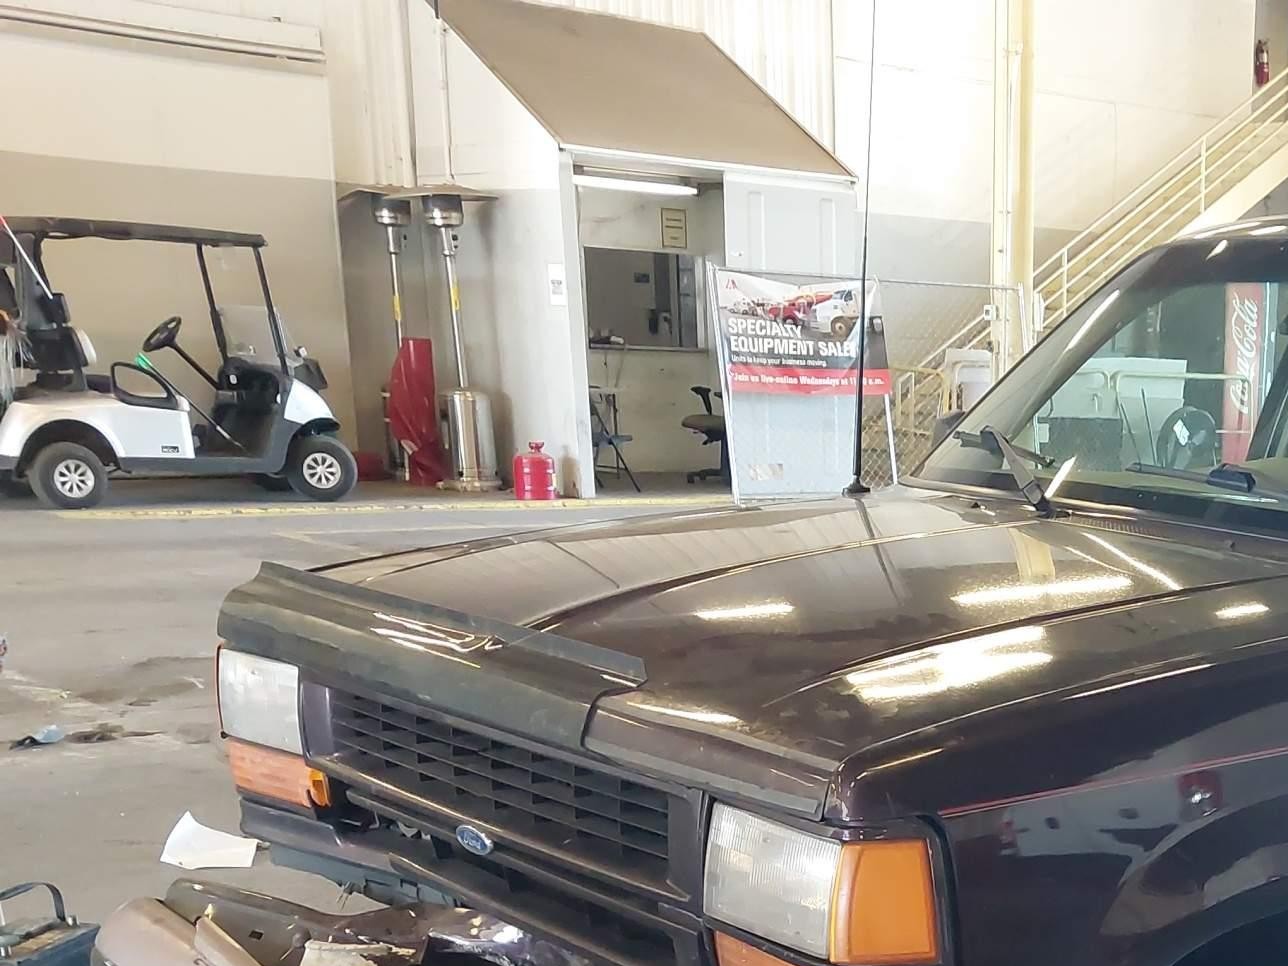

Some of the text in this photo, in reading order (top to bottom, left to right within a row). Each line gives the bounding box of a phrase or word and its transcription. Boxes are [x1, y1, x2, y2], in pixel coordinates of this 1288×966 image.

[728, 317, 802, 338] SPECIALTY
[730, 336, 814, 356] EQUIPMENT
[731, 355, 746, 363] Units
[768, 358, 780, 366] your
[734, 372, 749, 382] Join
[799, 375, 840, 387] Wednesdays
